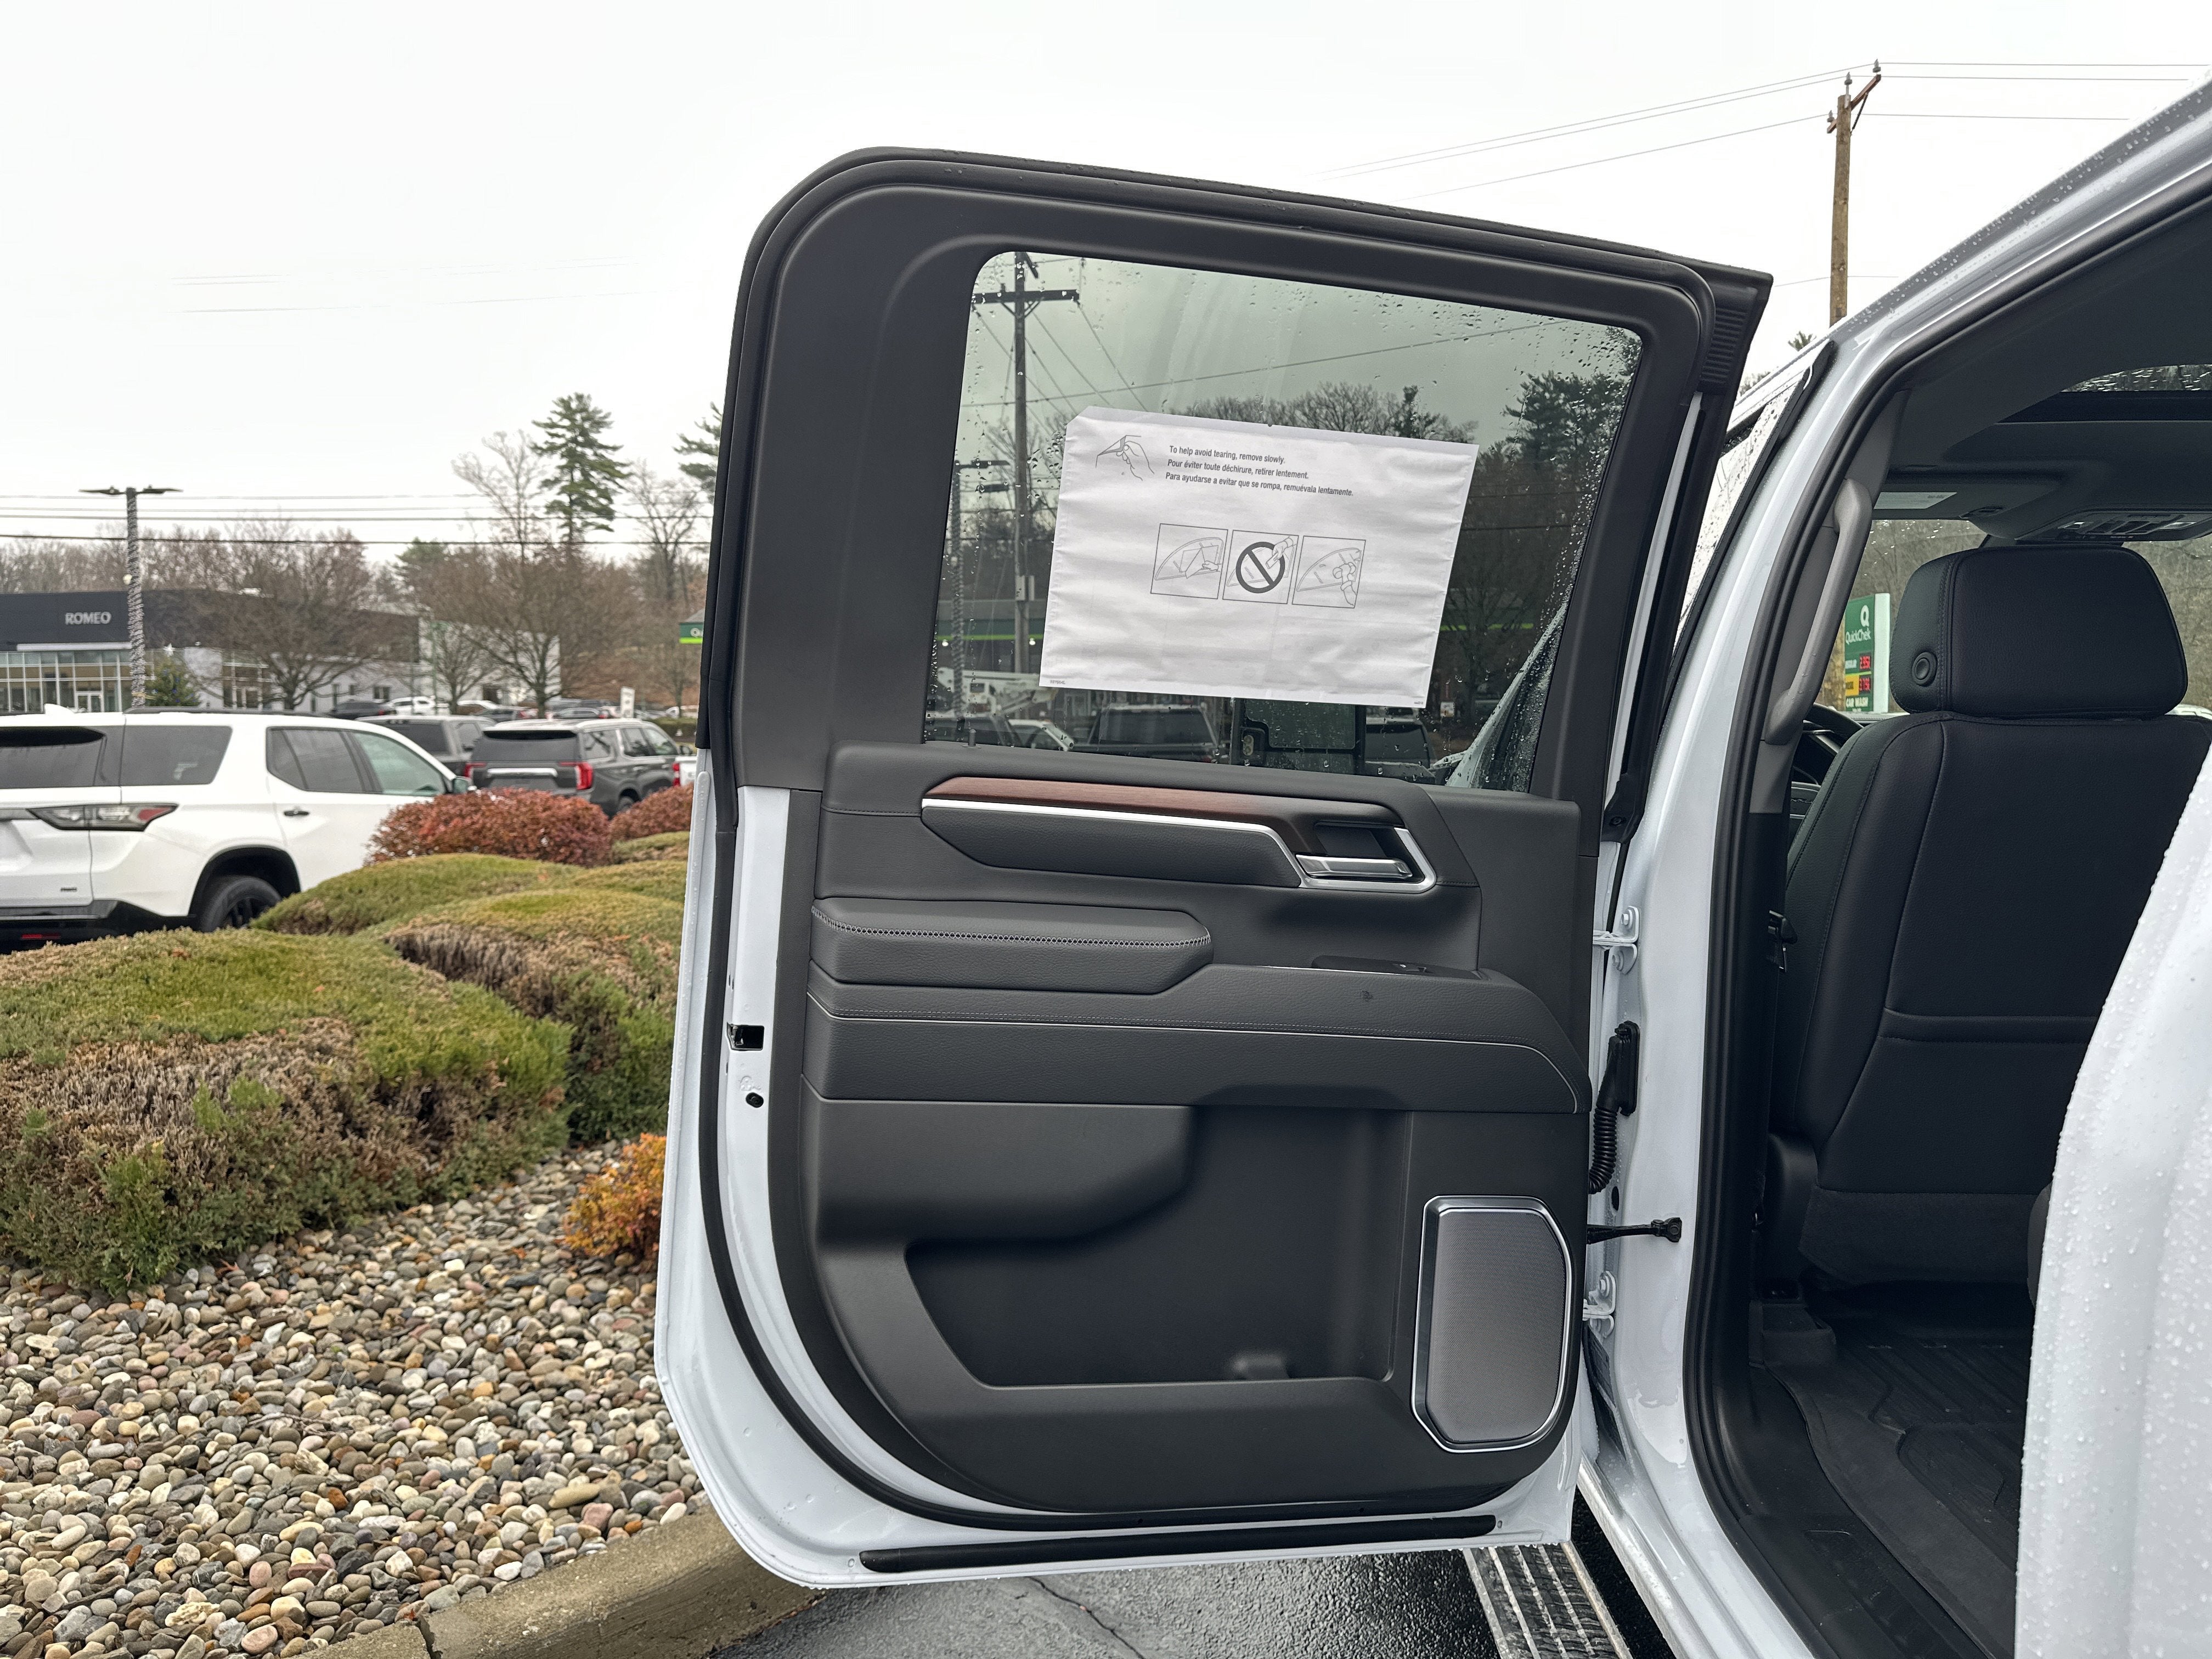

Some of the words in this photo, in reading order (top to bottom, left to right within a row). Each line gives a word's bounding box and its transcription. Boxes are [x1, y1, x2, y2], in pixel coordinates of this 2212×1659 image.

[1179, 447, 1193, 456] help
[1214, 450, 1238, 460] tearing,
[1239, 453, 1262, 461] remove
[1264, 455, 1285, 465] slowly.
[1167, 459, 1183, 467] Pour
[1184, 460, 1203, 469] éviter
[1204, 462, 1220, 471] toute
[1222, 464, 1254, 475] déchirure,
[1255, 467, 1274, 476] retirer
[1276, 469, 1309, 479] lentement.
[1165, 472, 1180, 481] Para
[1182, 474, 1211, 483] ayudarse
[1219, 477, 1237, 486] evitar
[1260, 482, 1282, 492] rompa,
[1283, 484, 1317, 493] remuévala
[1318, 486, 1353, 496] lentamente.
[65, 611, 112, 625] ROMEO
[1860, 605, 1870, 627] Q
